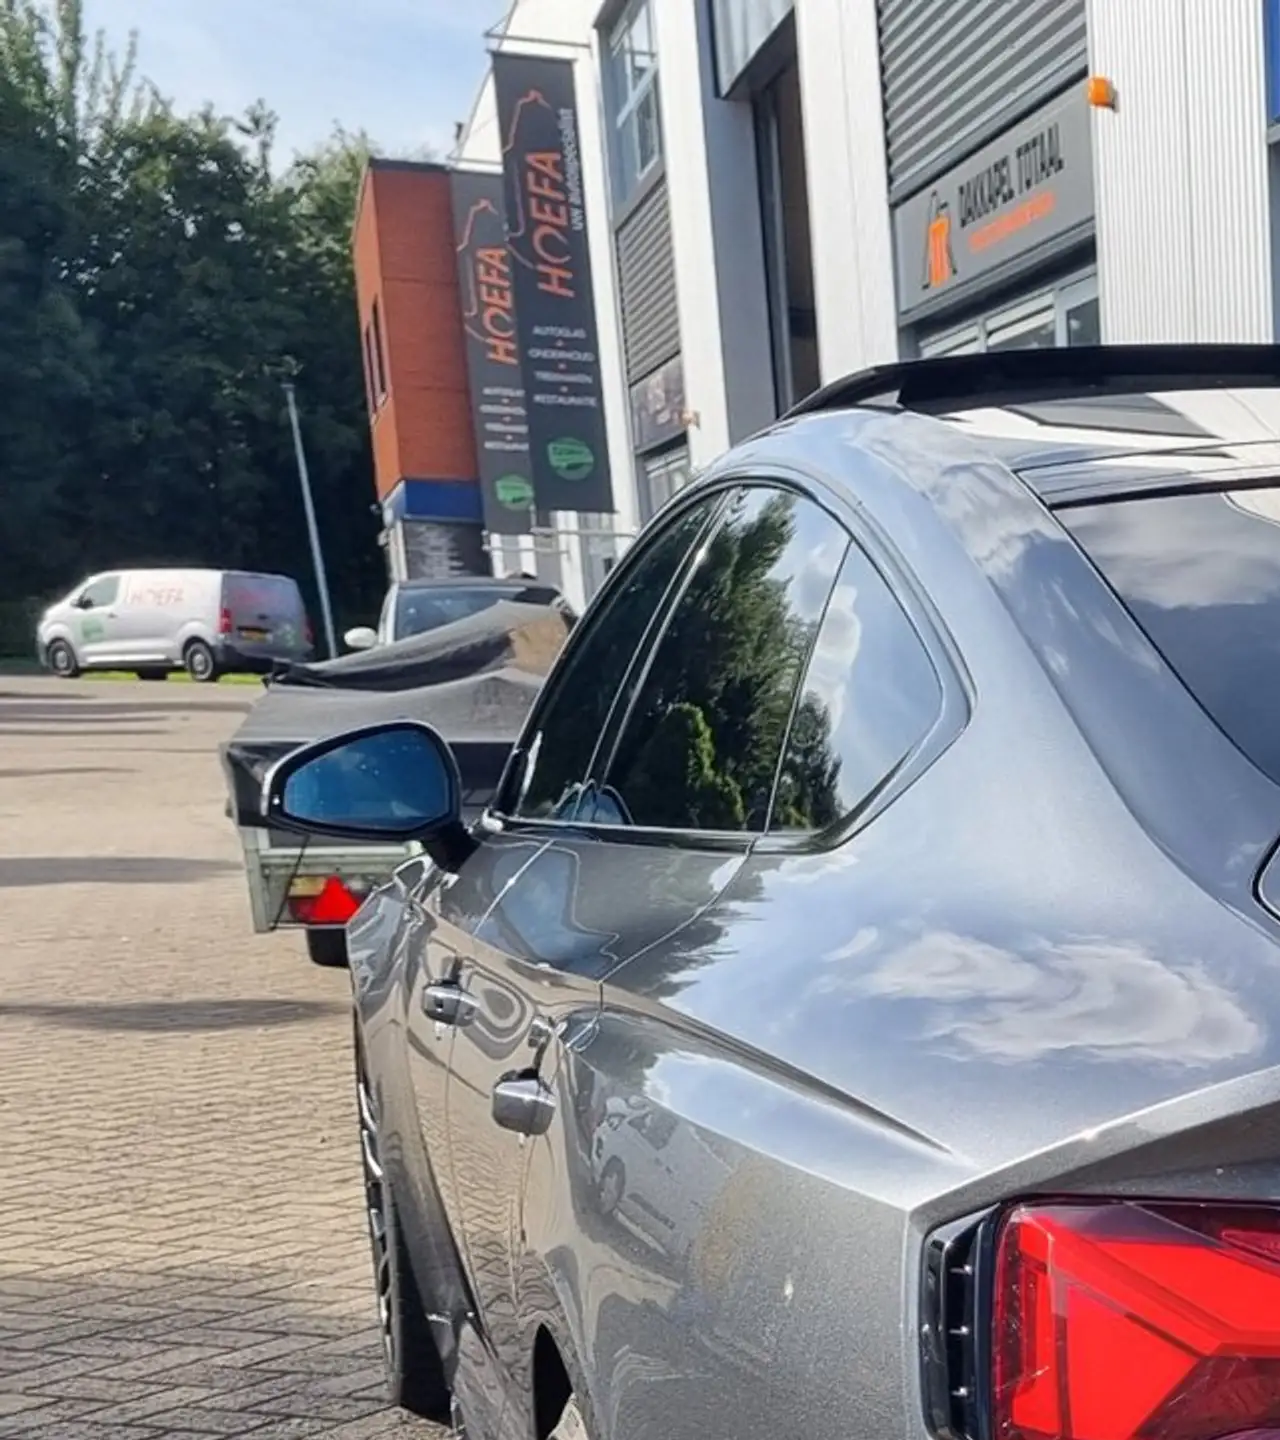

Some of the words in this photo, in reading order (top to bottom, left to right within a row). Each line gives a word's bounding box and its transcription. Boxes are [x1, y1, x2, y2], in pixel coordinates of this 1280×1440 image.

[525, 151, 575, 298] HOEFA
[958, 154, 1015, 229] DAKKAPEL
[1015, 122, 1064, 195] TOTAAL
[476, 247, 518, 365] HOEFA
